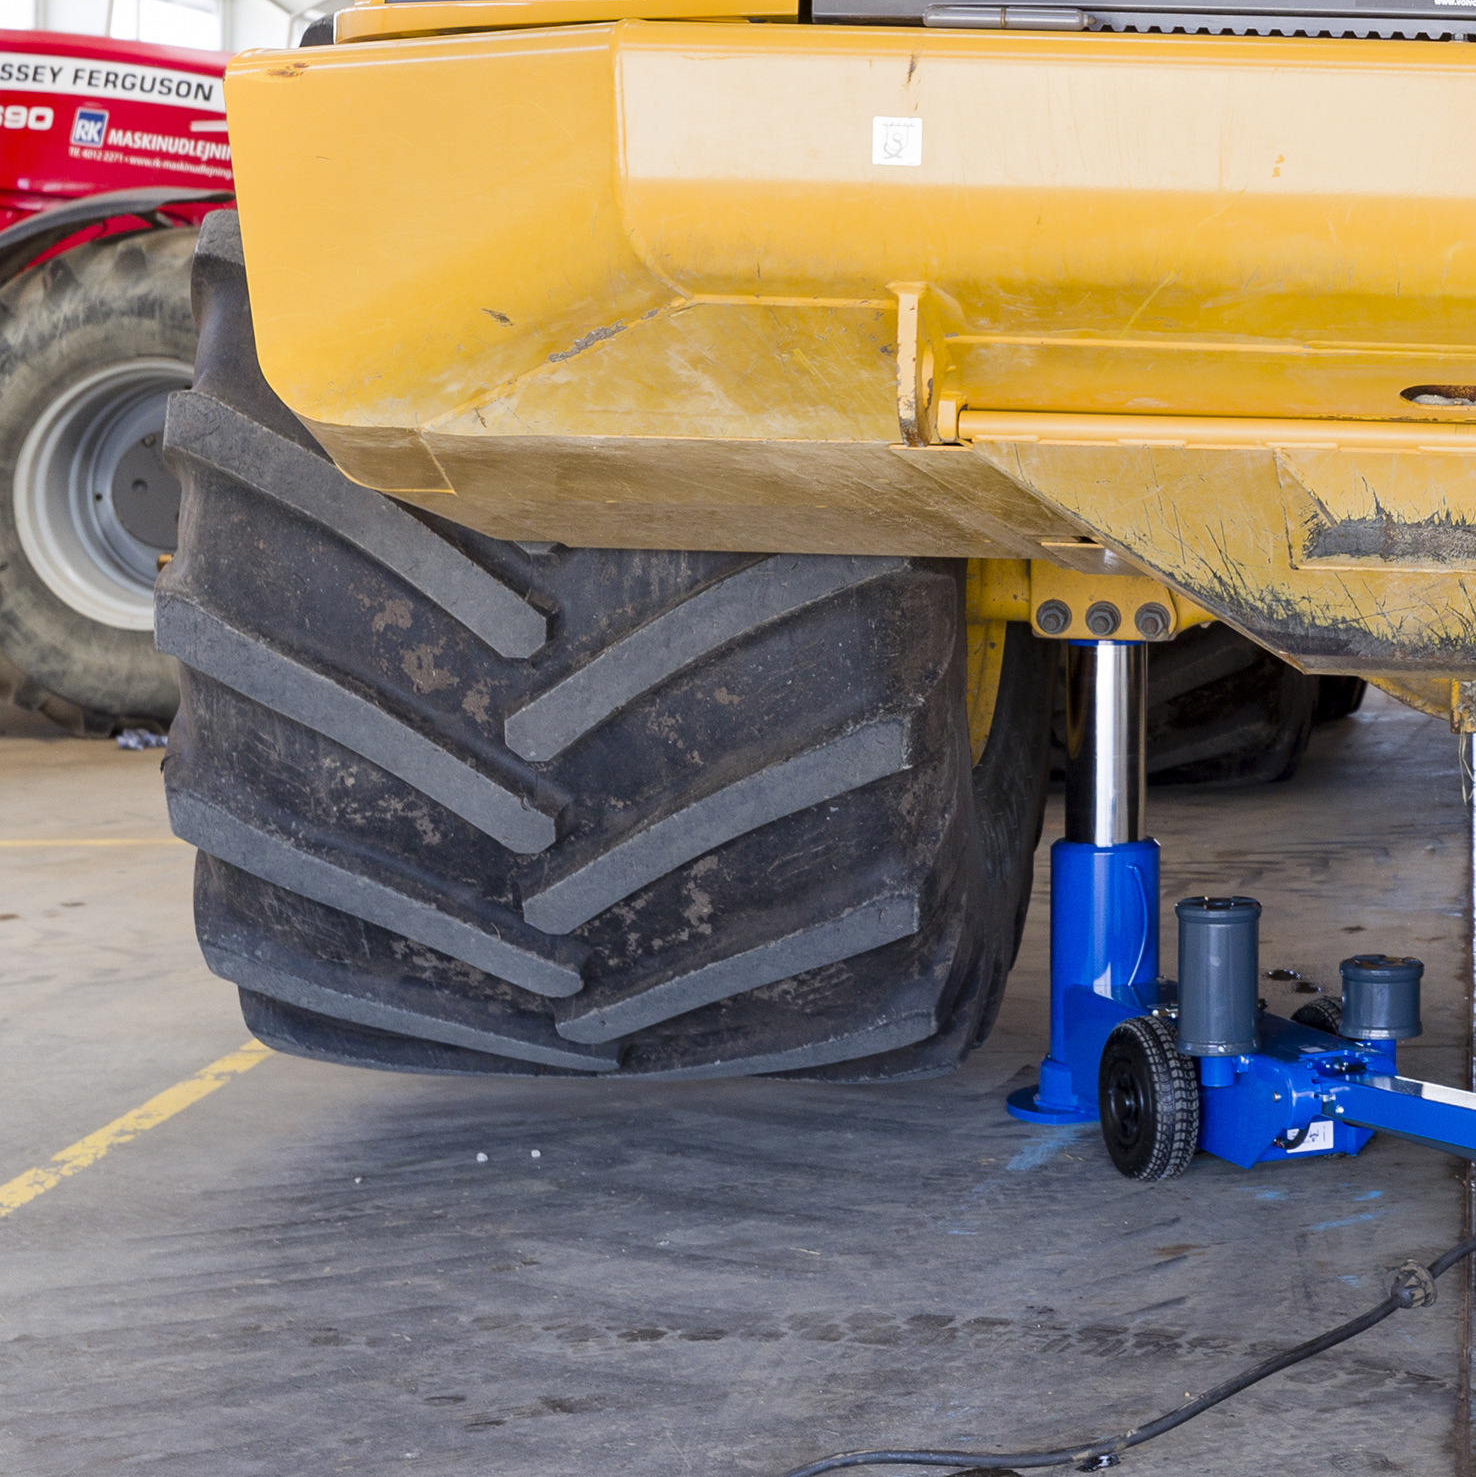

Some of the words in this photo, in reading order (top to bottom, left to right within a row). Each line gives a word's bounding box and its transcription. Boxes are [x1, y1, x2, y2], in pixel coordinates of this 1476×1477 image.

[72, 68, 214, 102] FERGUSON
[0, 105, 54, 131] 90
[74, 119, 102, 143] RK
[82, 148, 102, 161] 4012
[103, 151, 123, 164] 2271
